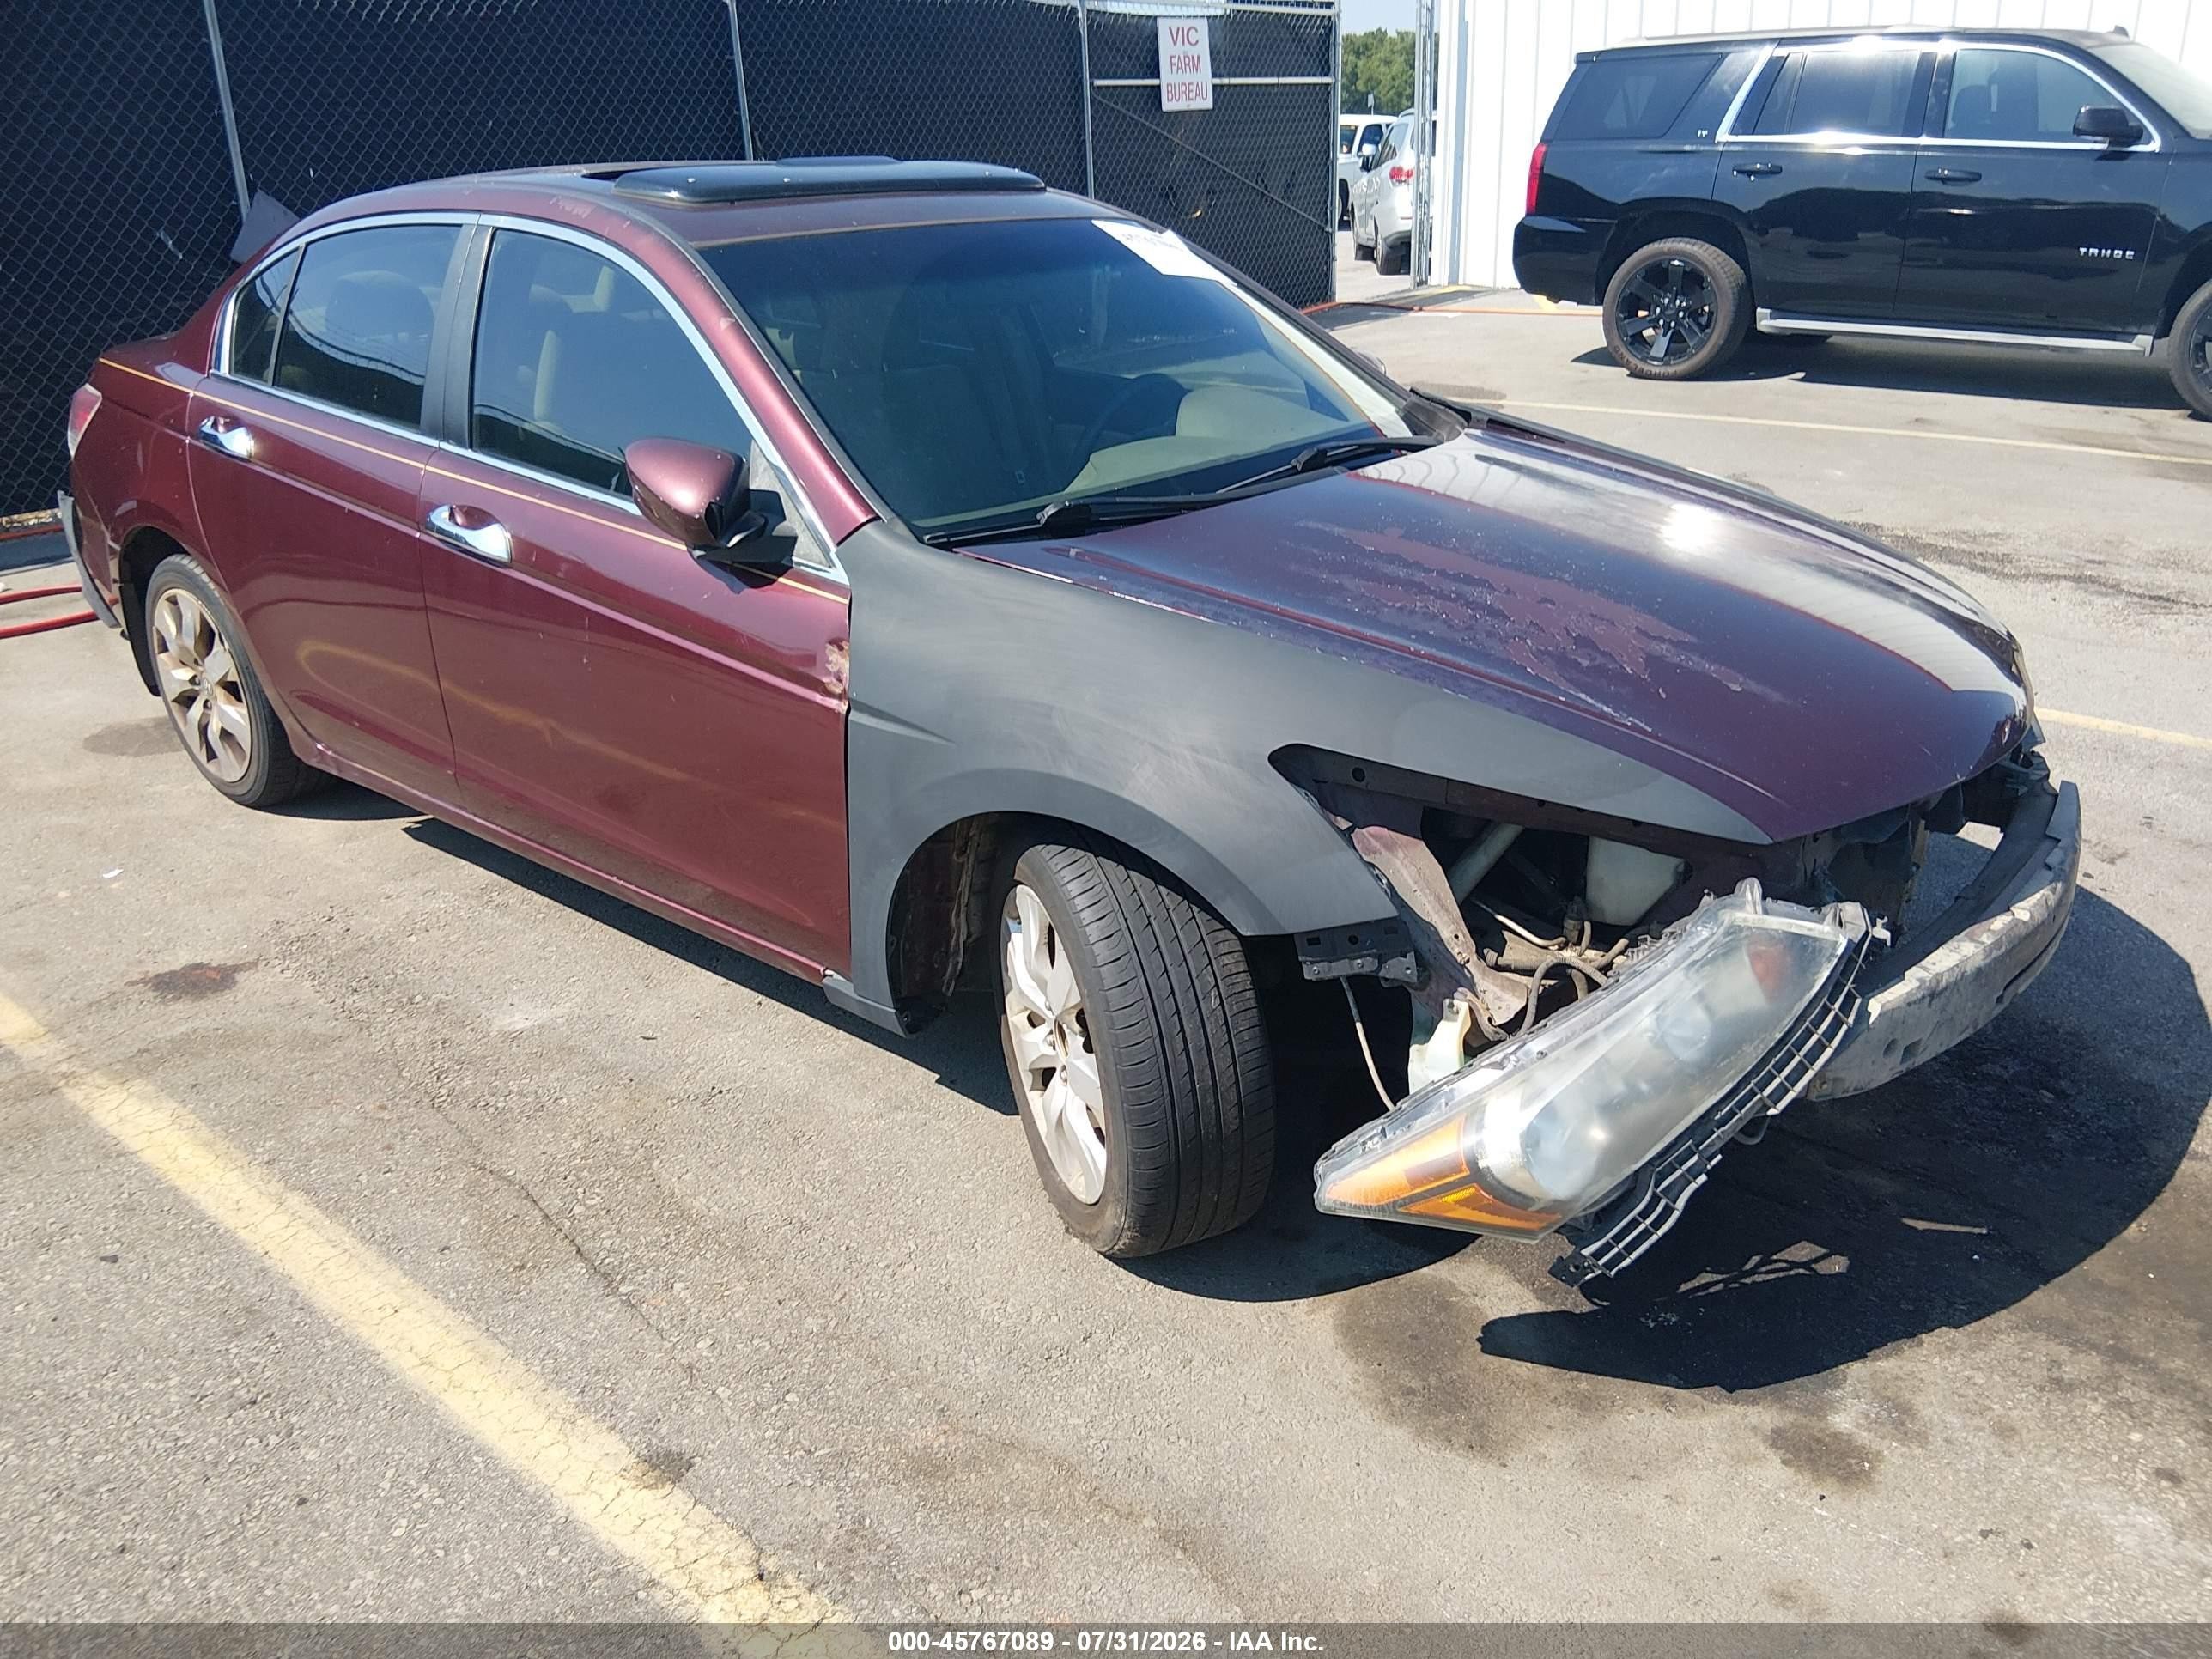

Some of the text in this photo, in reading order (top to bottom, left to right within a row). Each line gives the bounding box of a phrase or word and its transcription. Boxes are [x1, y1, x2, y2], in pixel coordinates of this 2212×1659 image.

[1169, 26, 1199, 46] VIC
[1170, 54, 1201, 75] FARM
[1166, 82, 1208, 102] BUREAU
[2079, 246, 2135, 260] TAHOE
